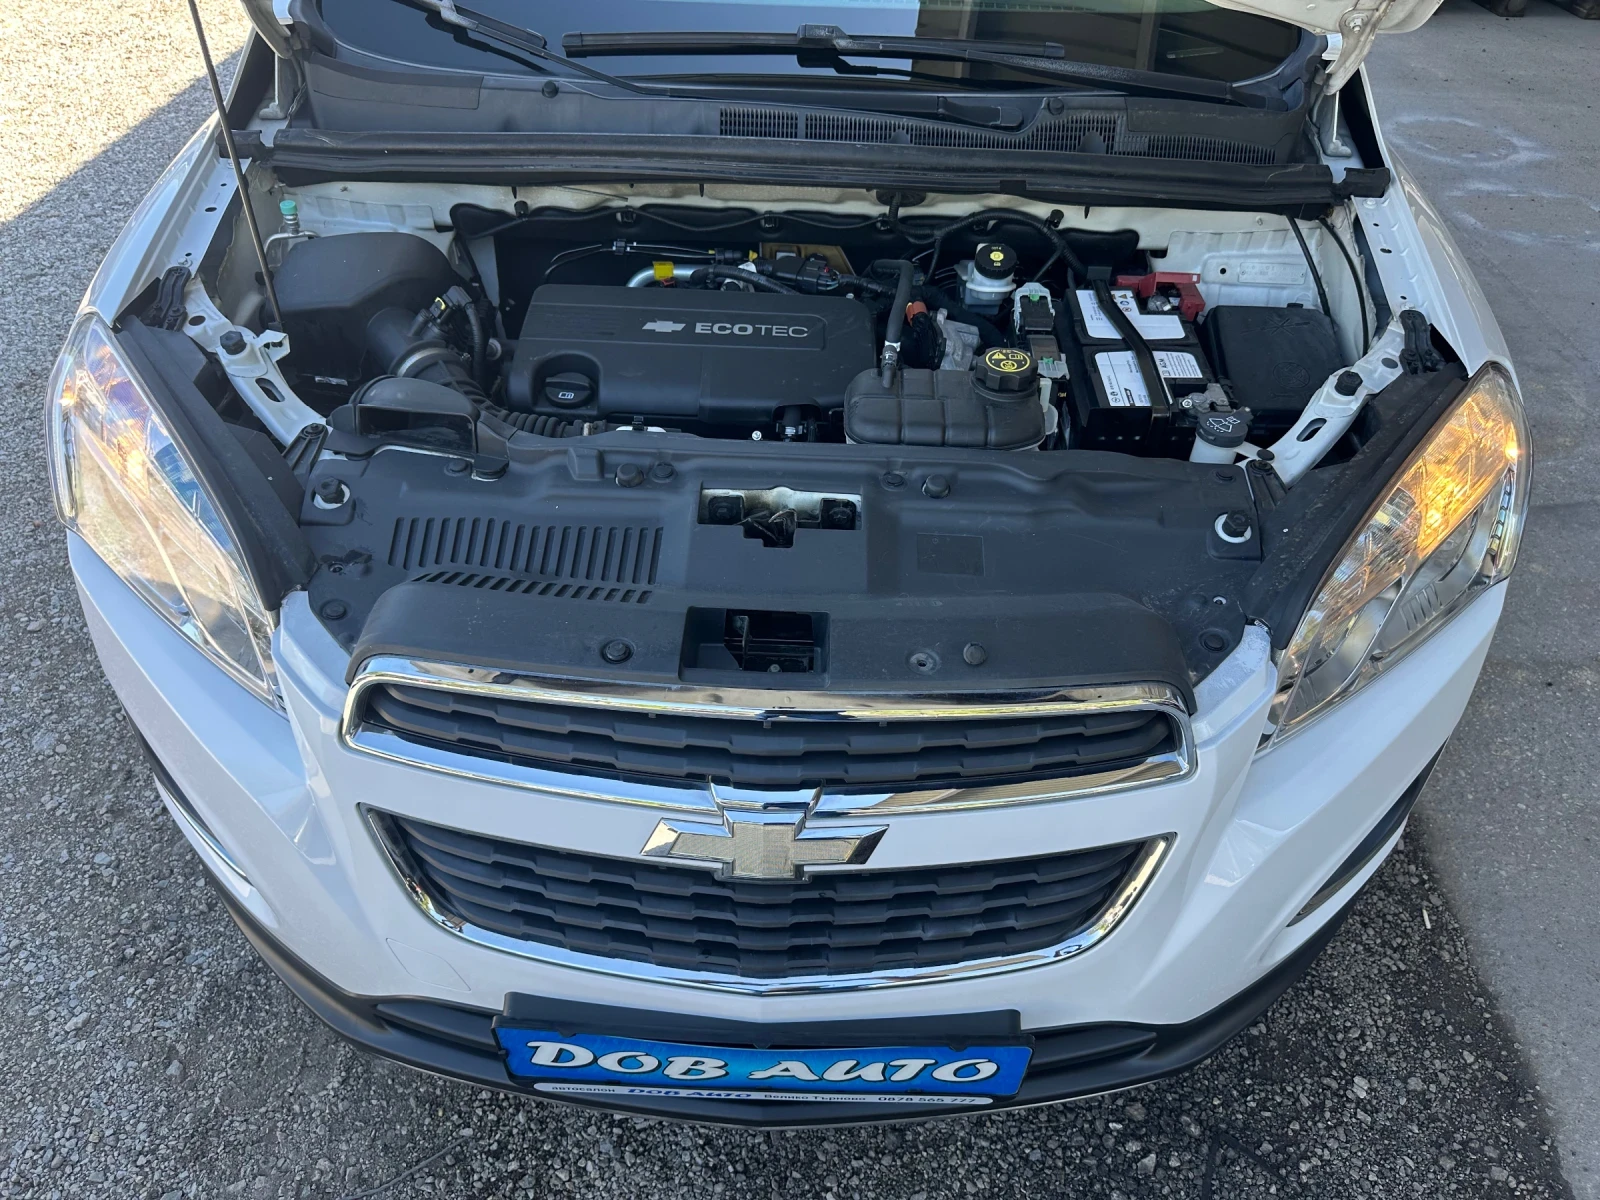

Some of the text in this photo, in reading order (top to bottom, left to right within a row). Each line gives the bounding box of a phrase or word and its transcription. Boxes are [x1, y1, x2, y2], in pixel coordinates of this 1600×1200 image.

[694, 322, 809, 338] ECOTEC
[527, 1041, 1000, 1082] DOB AUTO
[551, 1085, 616, 1093] автосалон
[627, 1088, 680, 1096] DOB
